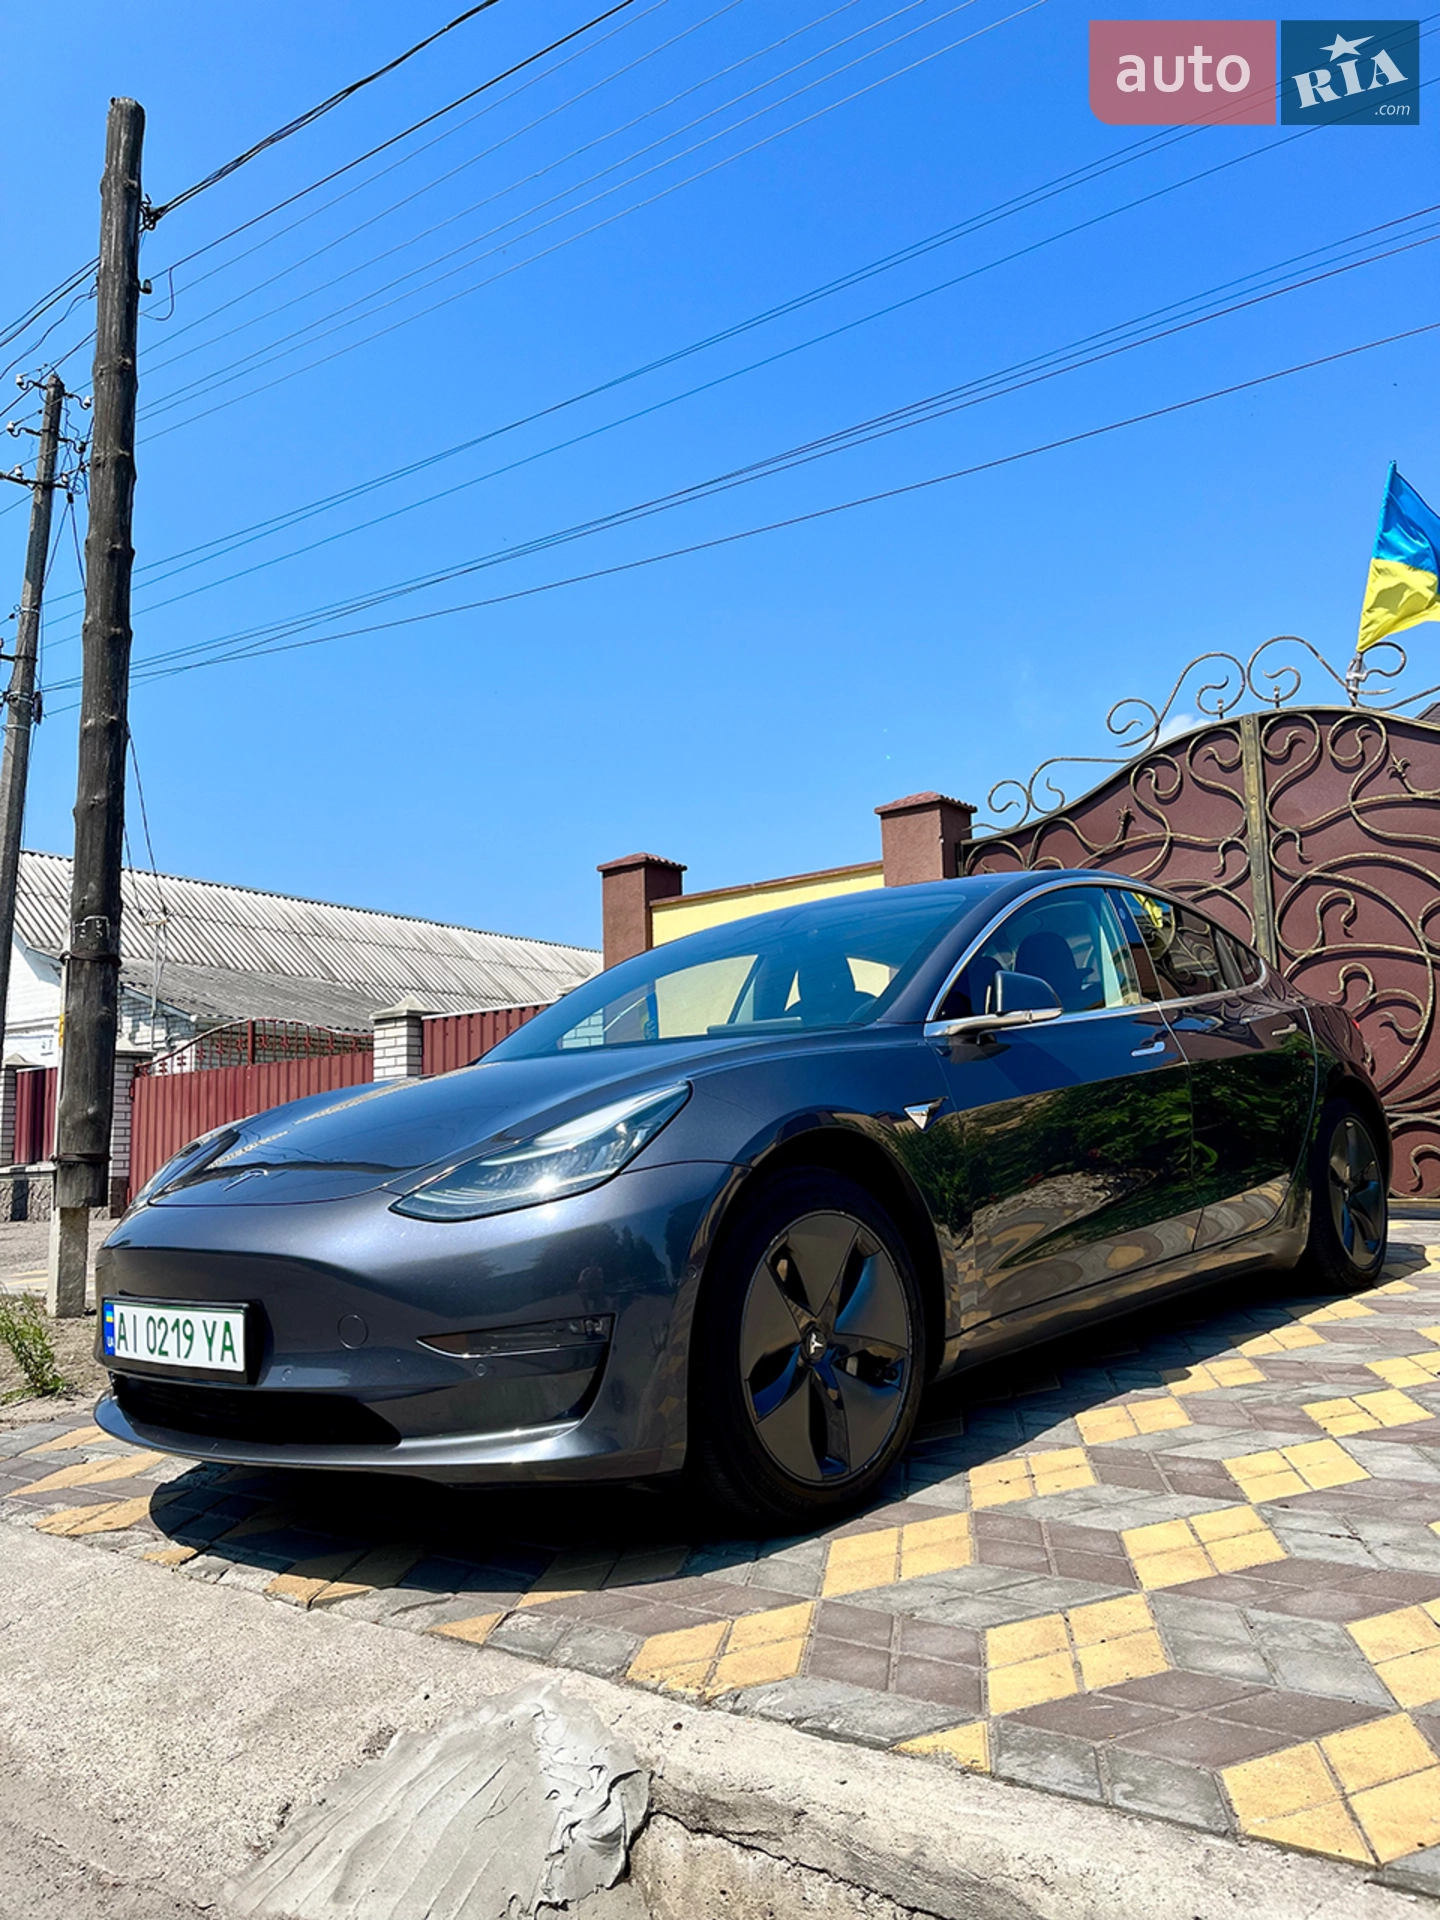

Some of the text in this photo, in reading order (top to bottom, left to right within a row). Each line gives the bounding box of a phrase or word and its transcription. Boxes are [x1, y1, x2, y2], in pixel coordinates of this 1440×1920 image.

[116, 1312, 237, 1363] AI 0219 YA
